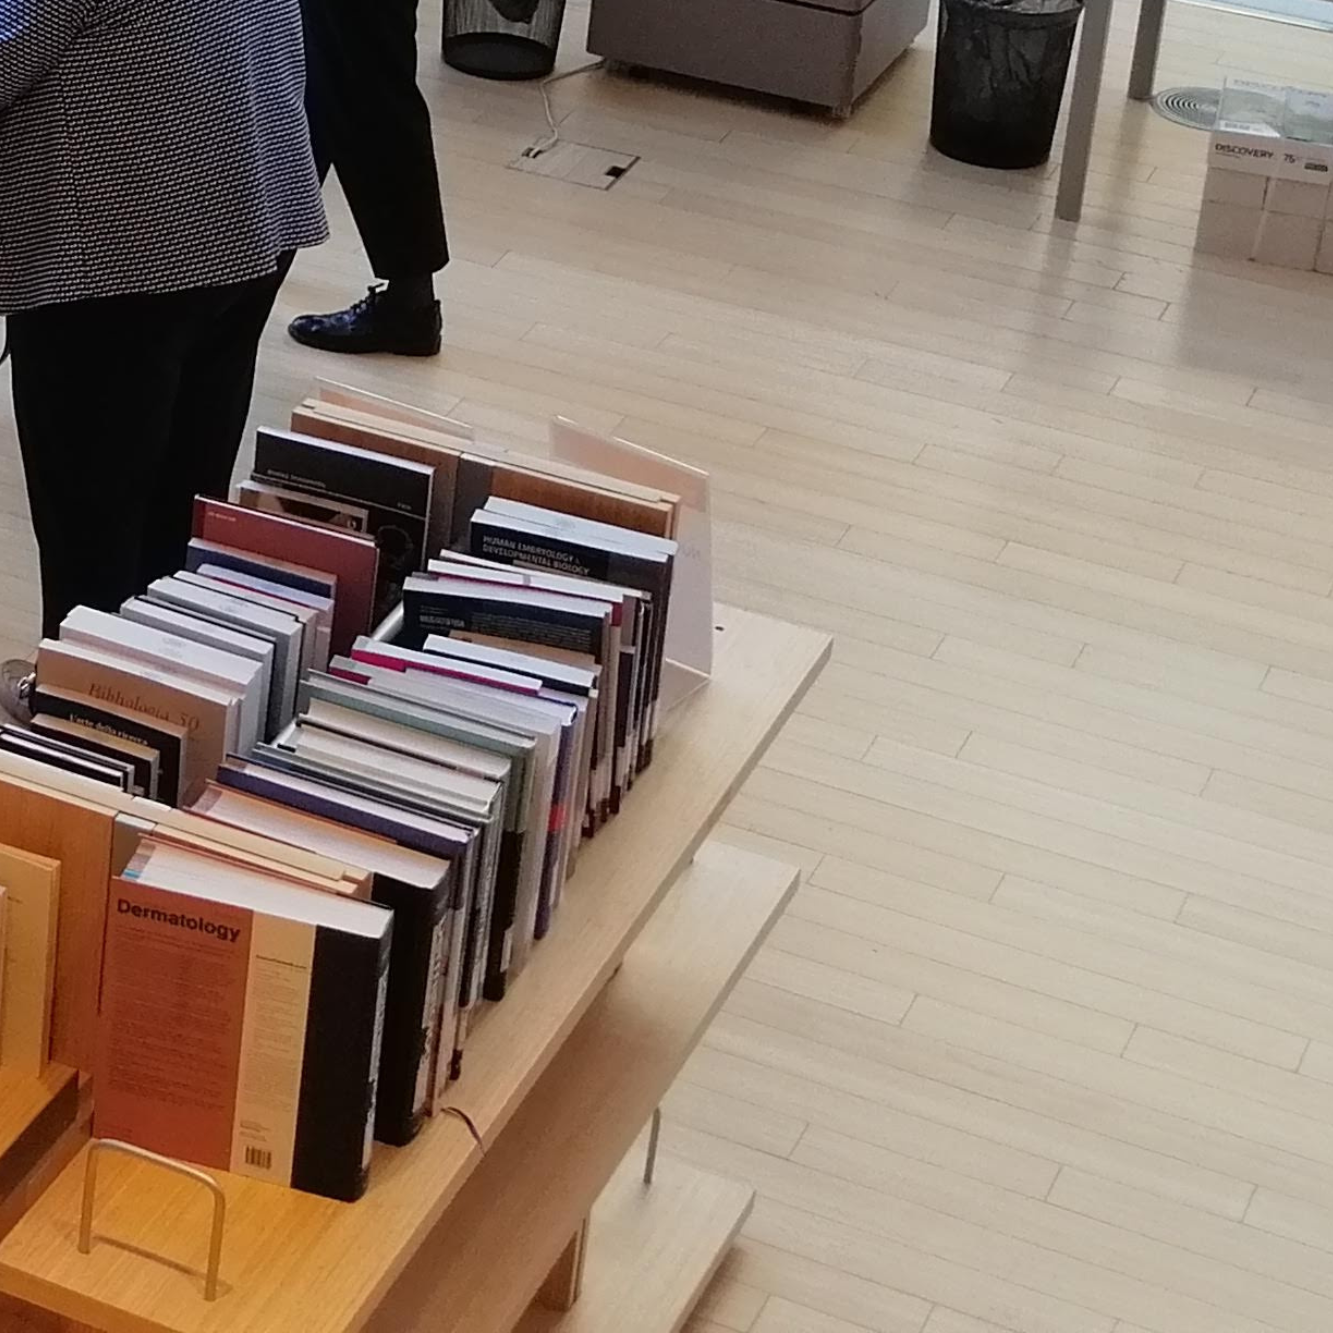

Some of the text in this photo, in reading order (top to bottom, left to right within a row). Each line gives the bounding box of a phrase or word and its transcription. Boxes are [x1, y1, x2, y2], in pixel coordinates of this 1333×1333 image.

[1215, 143, 1274, 158] DISCOVERY
[483, 535, 517, 550] HUMAN
[517, 541, 575, 563] EMBRYOLOGY
[483, 543, 590, 576] DEVELOPMENTAL BIOLOGY
[117, 898, 241, 943] Dermatology
